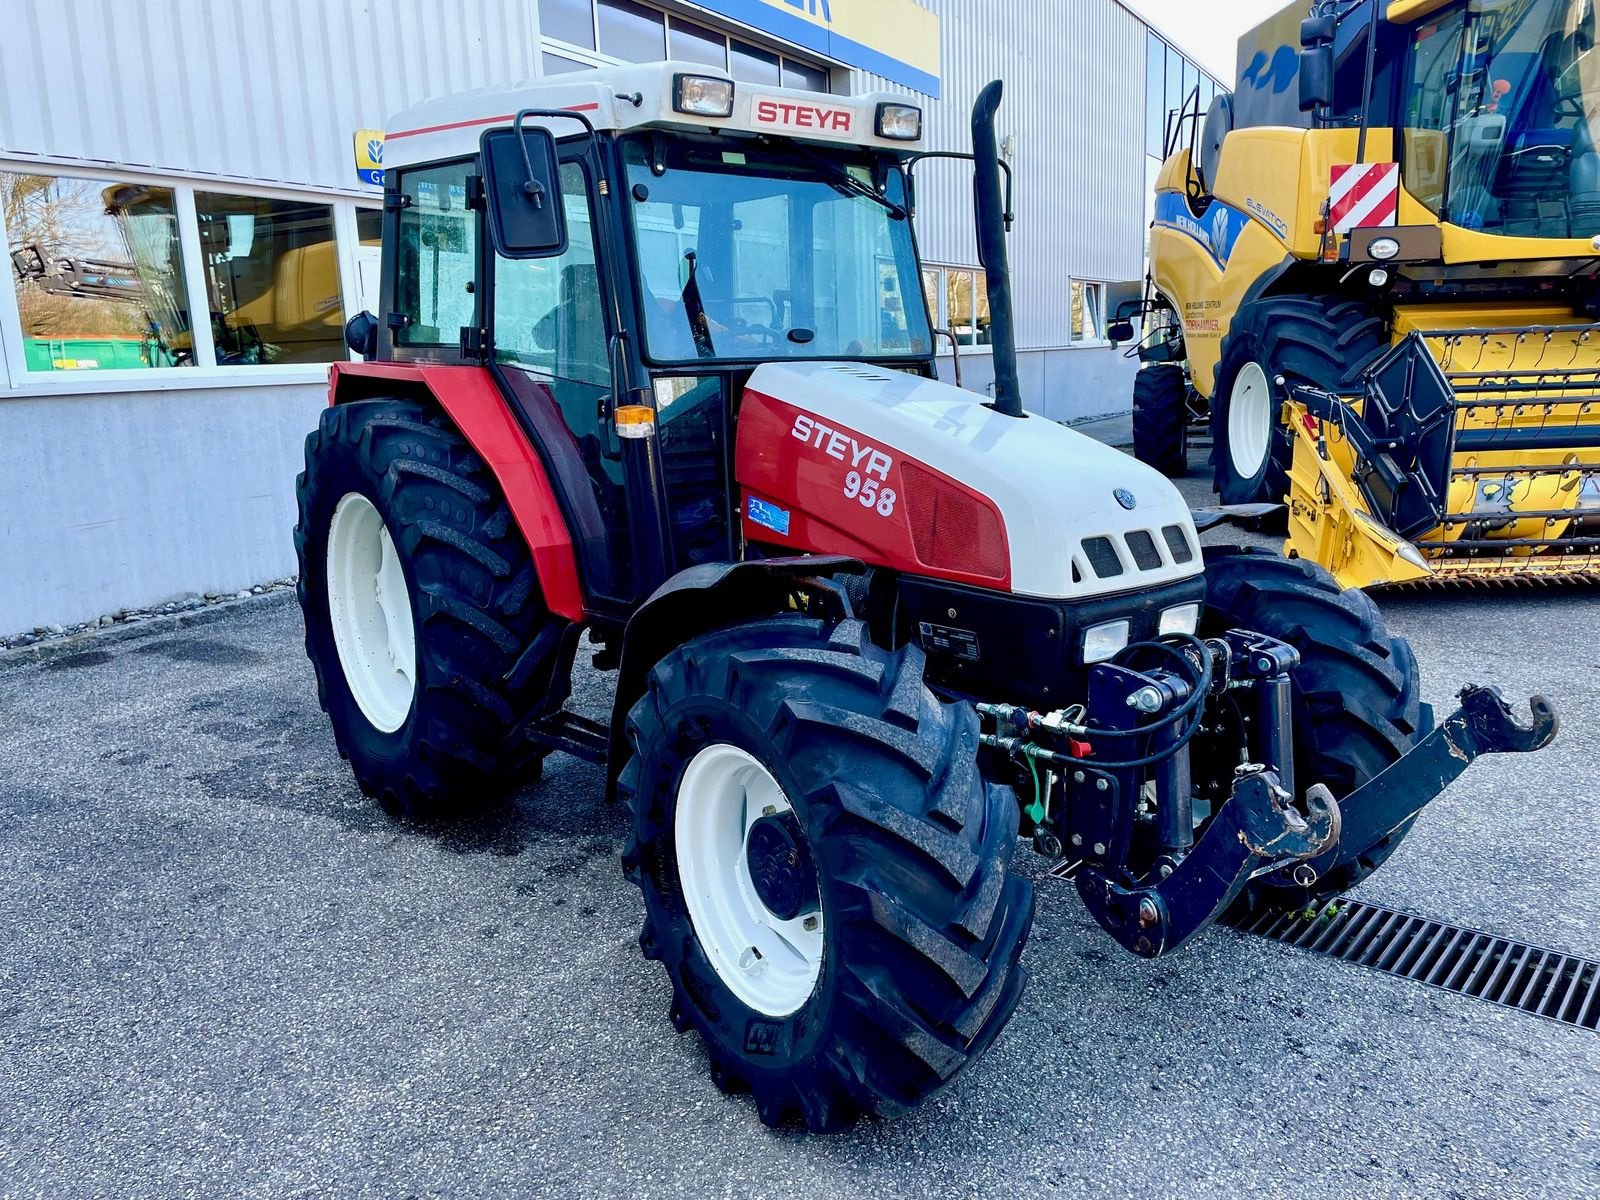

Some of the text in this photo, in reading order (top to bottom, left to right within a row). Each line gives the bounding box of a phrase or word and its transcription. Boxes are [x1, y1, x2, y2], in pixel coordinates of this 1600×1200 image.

[758, 102, 850, 131] STEYR
[1247, 198, 1288, 233] ELEVATION
[1188, 222, 1210, 245] HOLLAND
[791, 414, 893, 481] STEYR
[843, 470, 897, 517] 958
